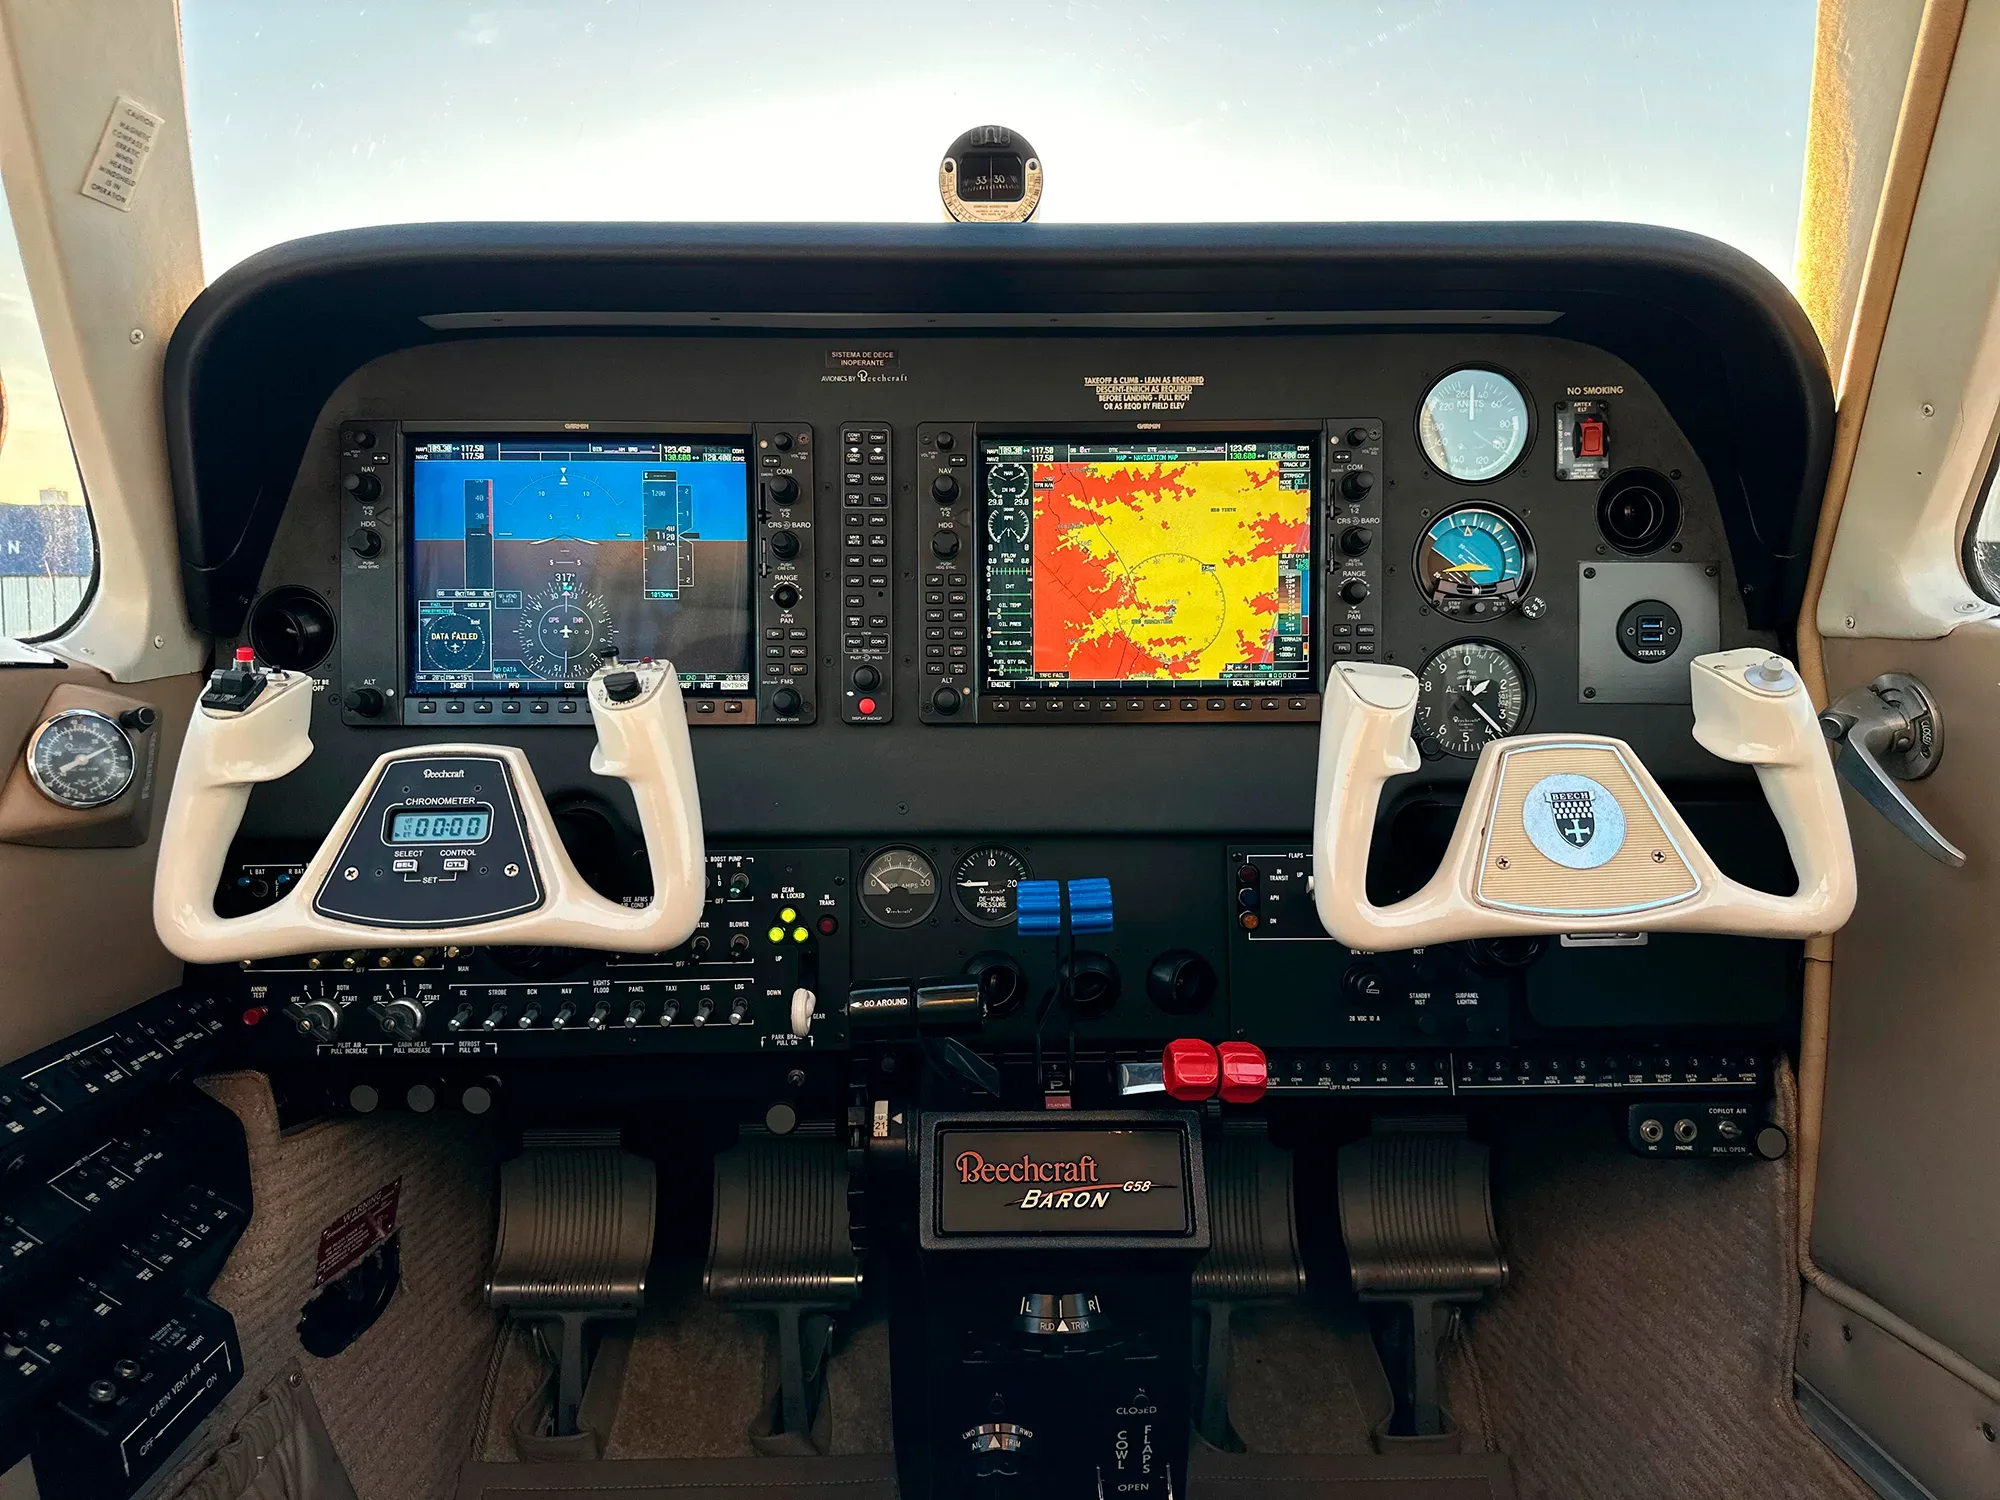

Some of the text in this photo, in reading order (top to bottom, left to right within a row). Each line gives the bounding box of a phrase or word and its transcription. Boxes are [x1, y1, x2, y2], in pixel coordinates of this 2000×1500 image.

[126, 108, 156, 128] CAUTION
[109, 160, 133, 175] HEATED
[98, 166, 136, 187] WINDSHIELD
[975, 175, 1005, 185] 33 30
[90, 183, 127, 204] OPERATION
[857, 370, 908, 382] Beechcraft
[1567, 386, 1624, 395] NO SMOKING
[1450, 456, 1464, 464] 140
[1534, 598, 1545, 608] PULL
[1464, 656, 1471, 666] 0
[1439, 664, 1447, 674] 9
[1425, 681, 1432, 692] 8
[1500, 679, 1507, 690] 2
[1425, 707, 1431, 718] 7
[1499, 709, 1506, 719] 3
[1439, 724, 1447, 734] 6
[1485, 725, 1493, 735] 4
[1462, 732, 1470, 742] 5
[423, 769, 465, 778] Beechcraft
[405, 796, 476, 806] CHRONOMETER
[415, 817, 481, 837] 00:00
[988, 858, 996, 867] 10
[1007, 880, 1018, 888] 20
[876, 998, 908, 1007] AROUND
[955, 1150, 1098, 1184] Beechcraft
[1123, 1180, 1151, 1192] G58
[1020, 1189, 1110, 1209] BARON
[343, 1191, 382, 1222] WARNING
[1026, 1301, 1032, 1312] L
[1088, 1300, 1096, 1311] R
[1040, 1322, 1055, 1331] RUD
[1071, 1321, 1090, 1330] TRIM
[186, 1335, 205, 1351] FLIGHT
[206, 1372, 218, 1388] ON
[149, 1362, 201, 1418] CABIN VENT AIR
[1116, 1406, 1157, 1415] CLOSED
[962, 1428, 976, 1440] LWD
[1019, 1428, 1033, 1438] RWD
[140, 1437, 155, 1456] OFF
[972, 1440, 982, 1450] AIL
[1005, 1439, 1021, 1448] TRIM
[1118, 1483, 1149, 1492] OPEN
